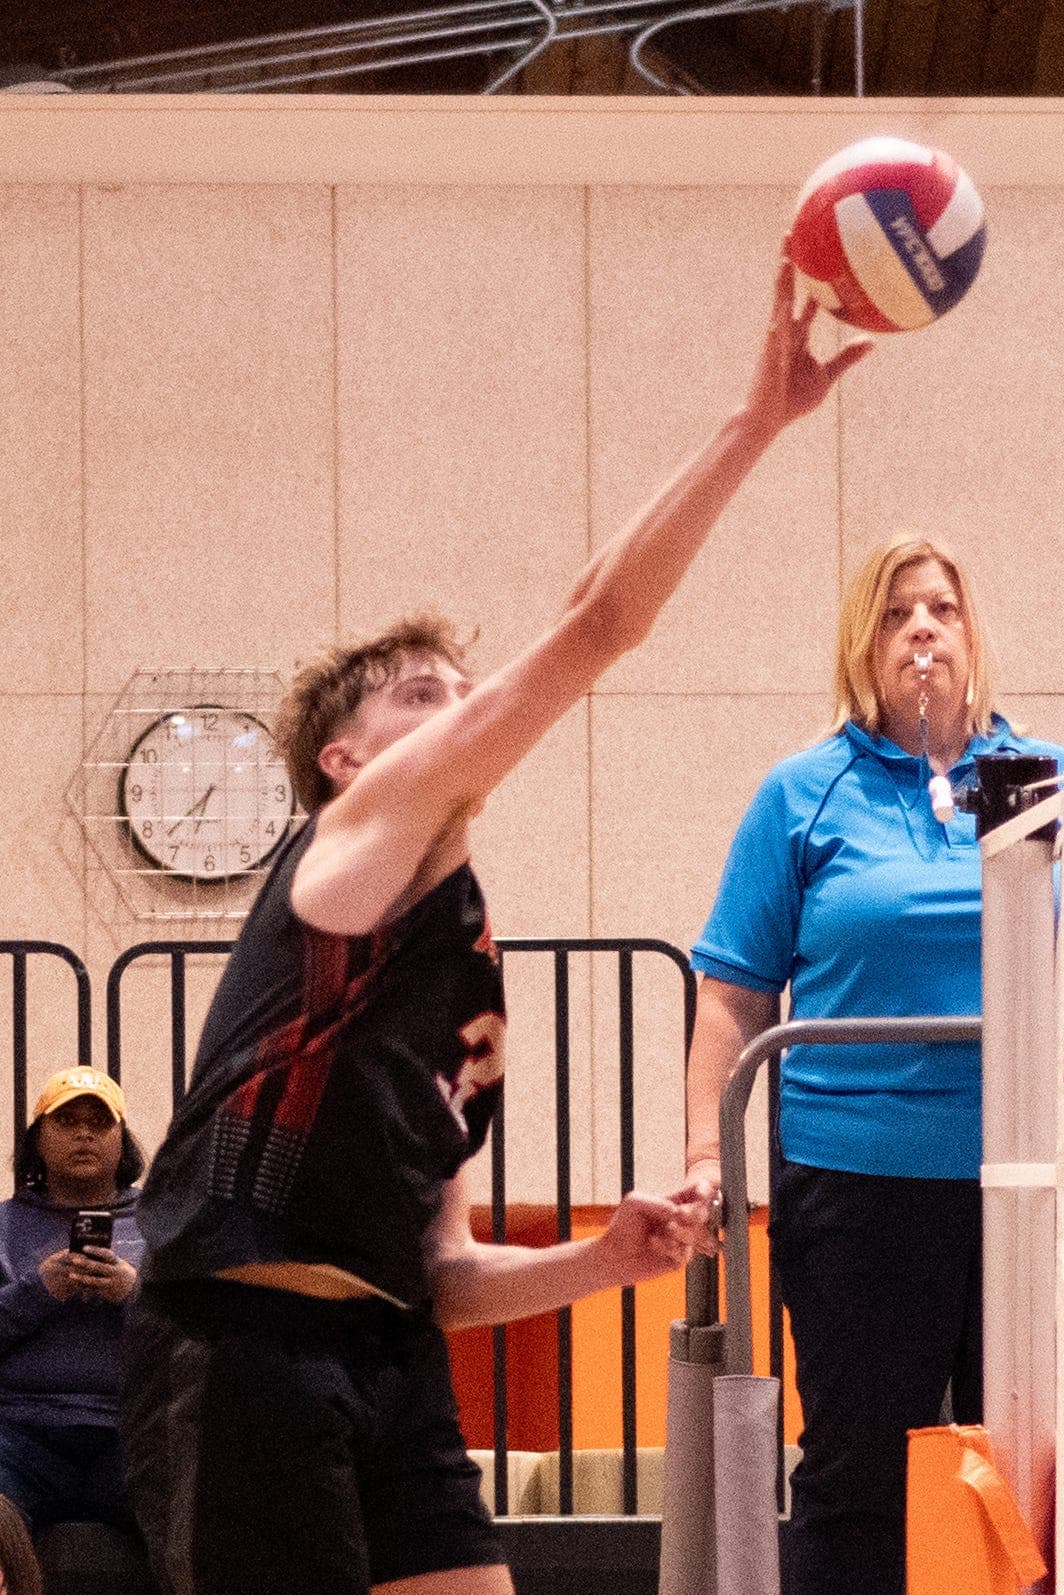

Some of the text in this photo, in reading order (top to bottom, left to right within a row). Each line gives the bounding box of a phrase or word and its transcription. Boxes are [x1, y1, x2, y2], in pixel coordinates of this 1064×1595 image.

[200, 713, 219, 731] 12
[131, 784, 143, 802] 9
[275, 784, 286, 802] 3
[142, 820, 153, 838] 8
[265, 820, 277, 837] 4
[168, 845, 180, 861] 7
[240, 845, 251, 863] 5
[204, 855, 216, 871] 6
